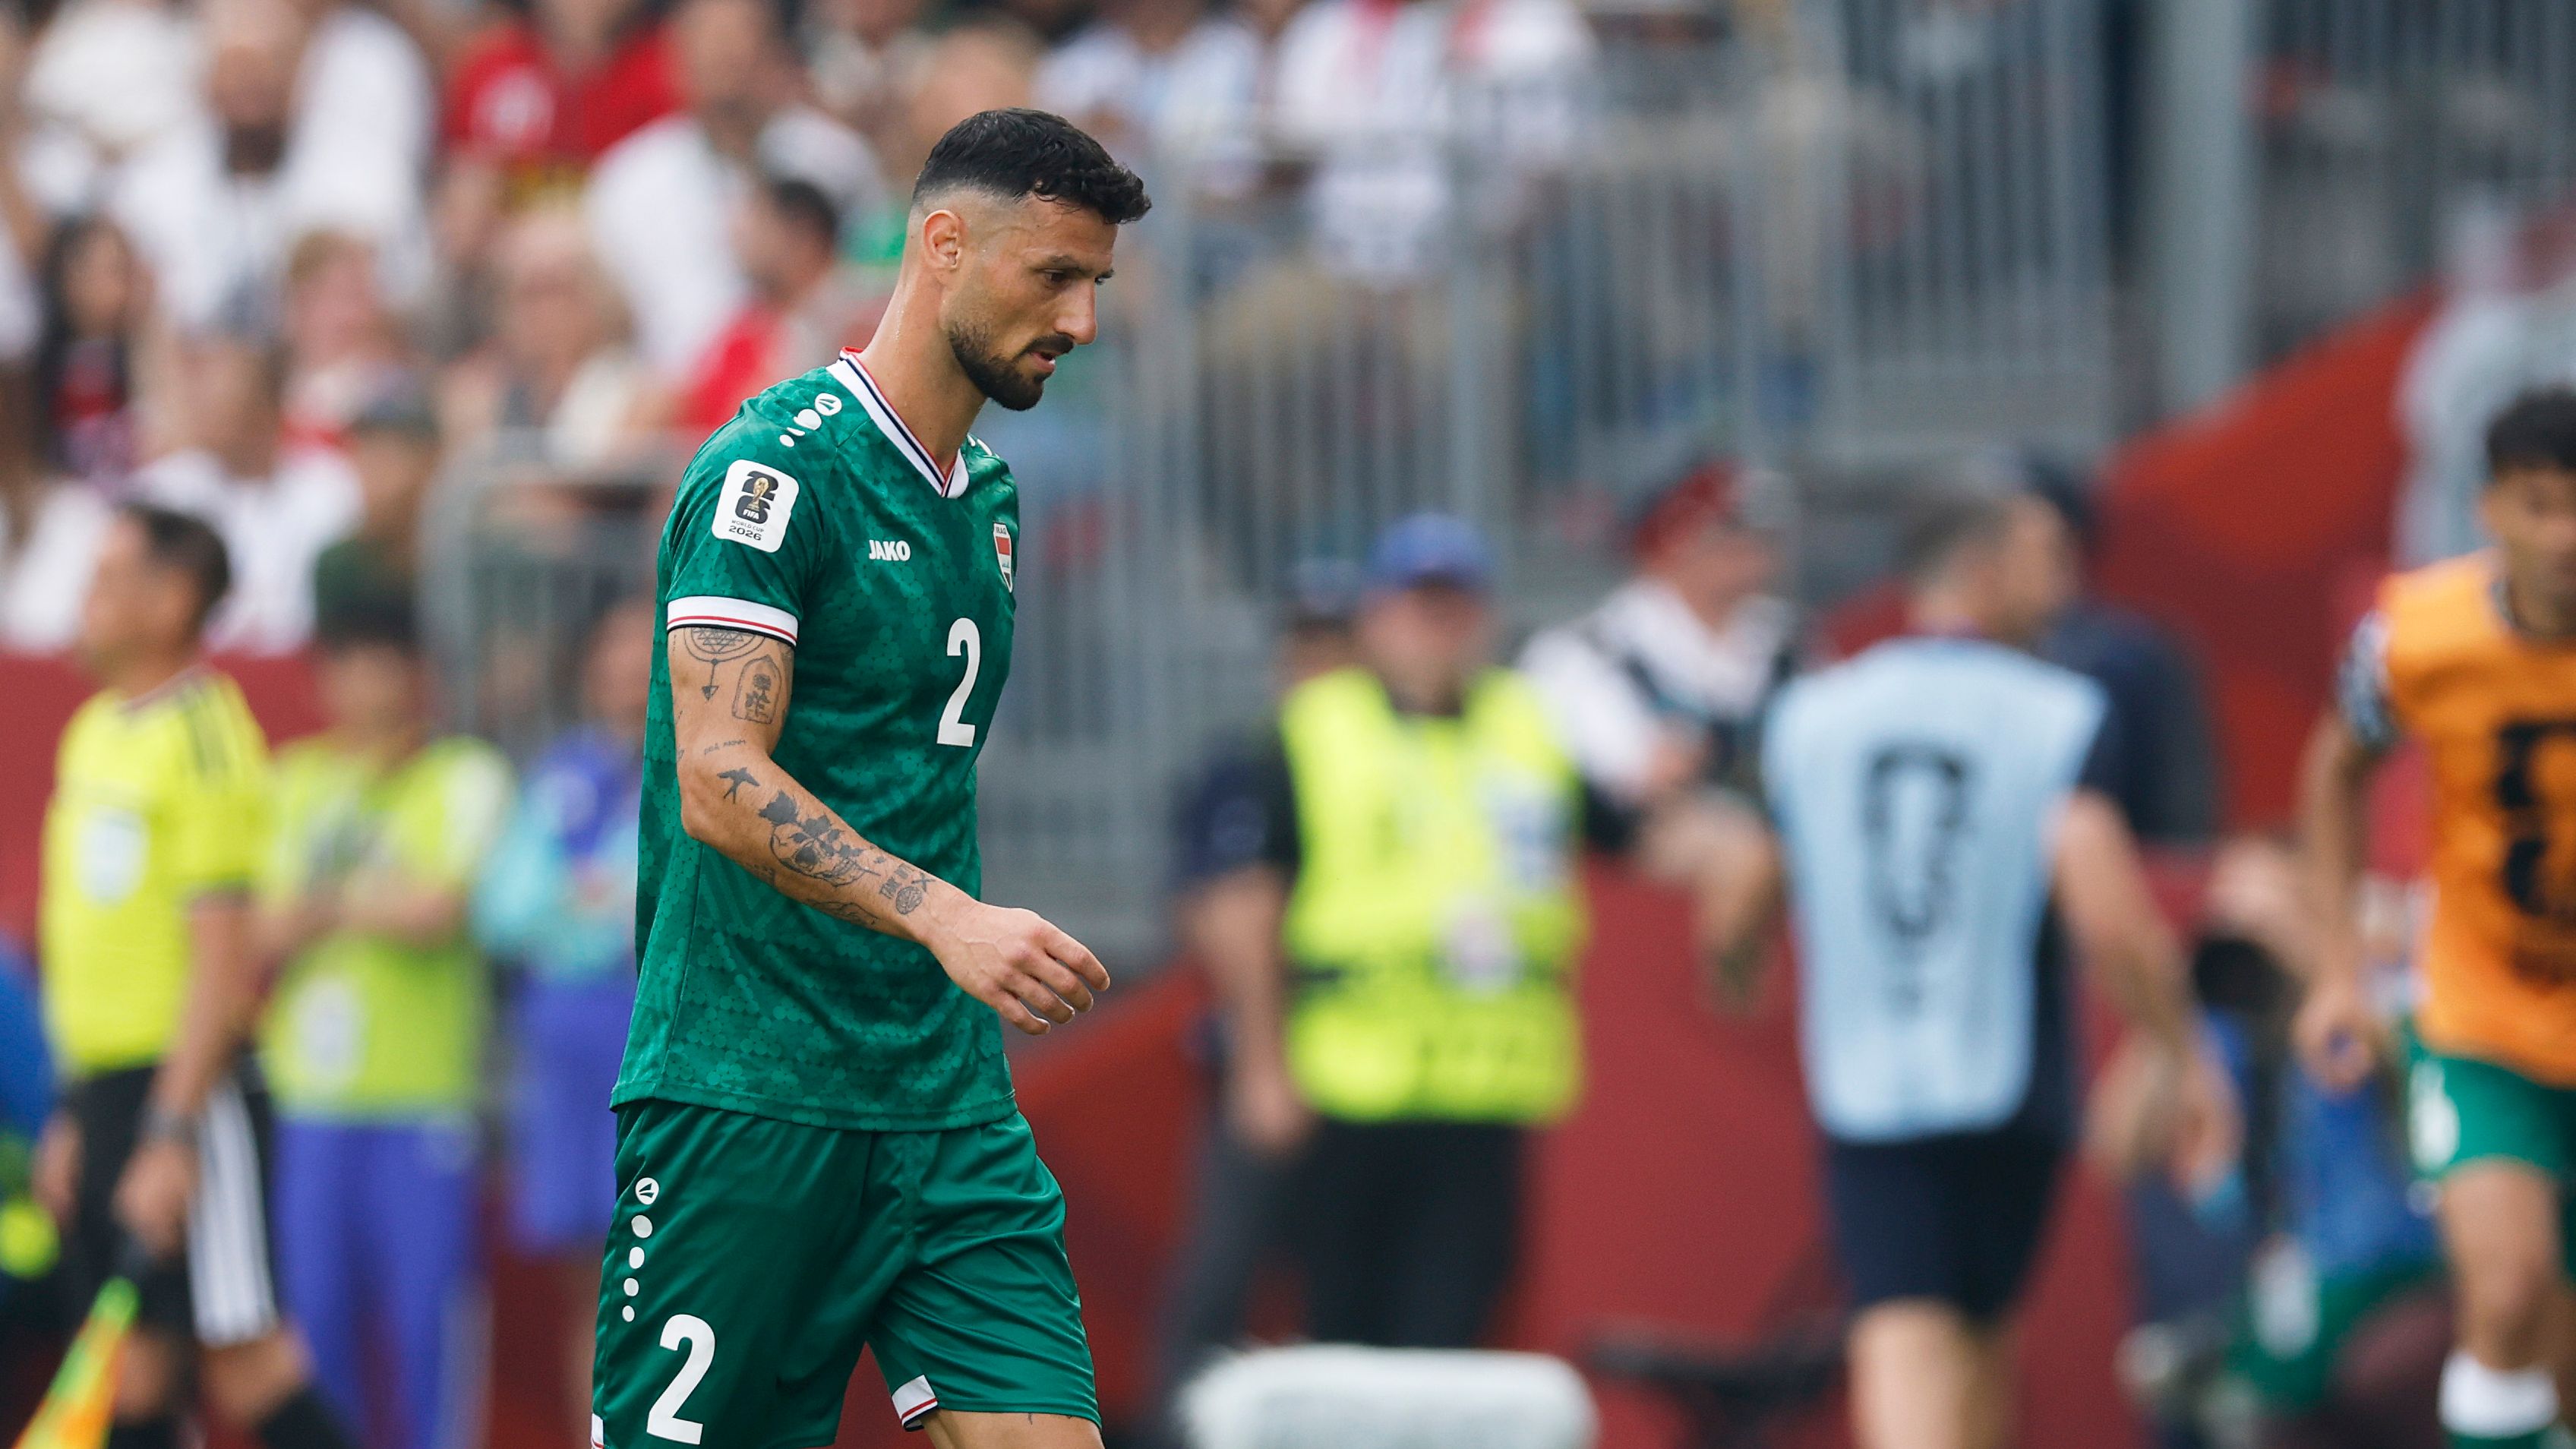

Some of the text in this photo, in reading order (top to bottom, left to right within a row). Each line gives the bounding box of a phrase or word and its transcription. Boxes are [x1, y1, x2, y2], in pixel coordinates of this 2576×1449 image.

[743, 509, 759, 519] FIFA
[728, 525, 762, 541] 2026
[731, 519, 752, 529] WORLD
[869, 539, 911, 561] JAKO
[936, 617, 980, 747] 2
[646, 1314, 715, 1445] 2
